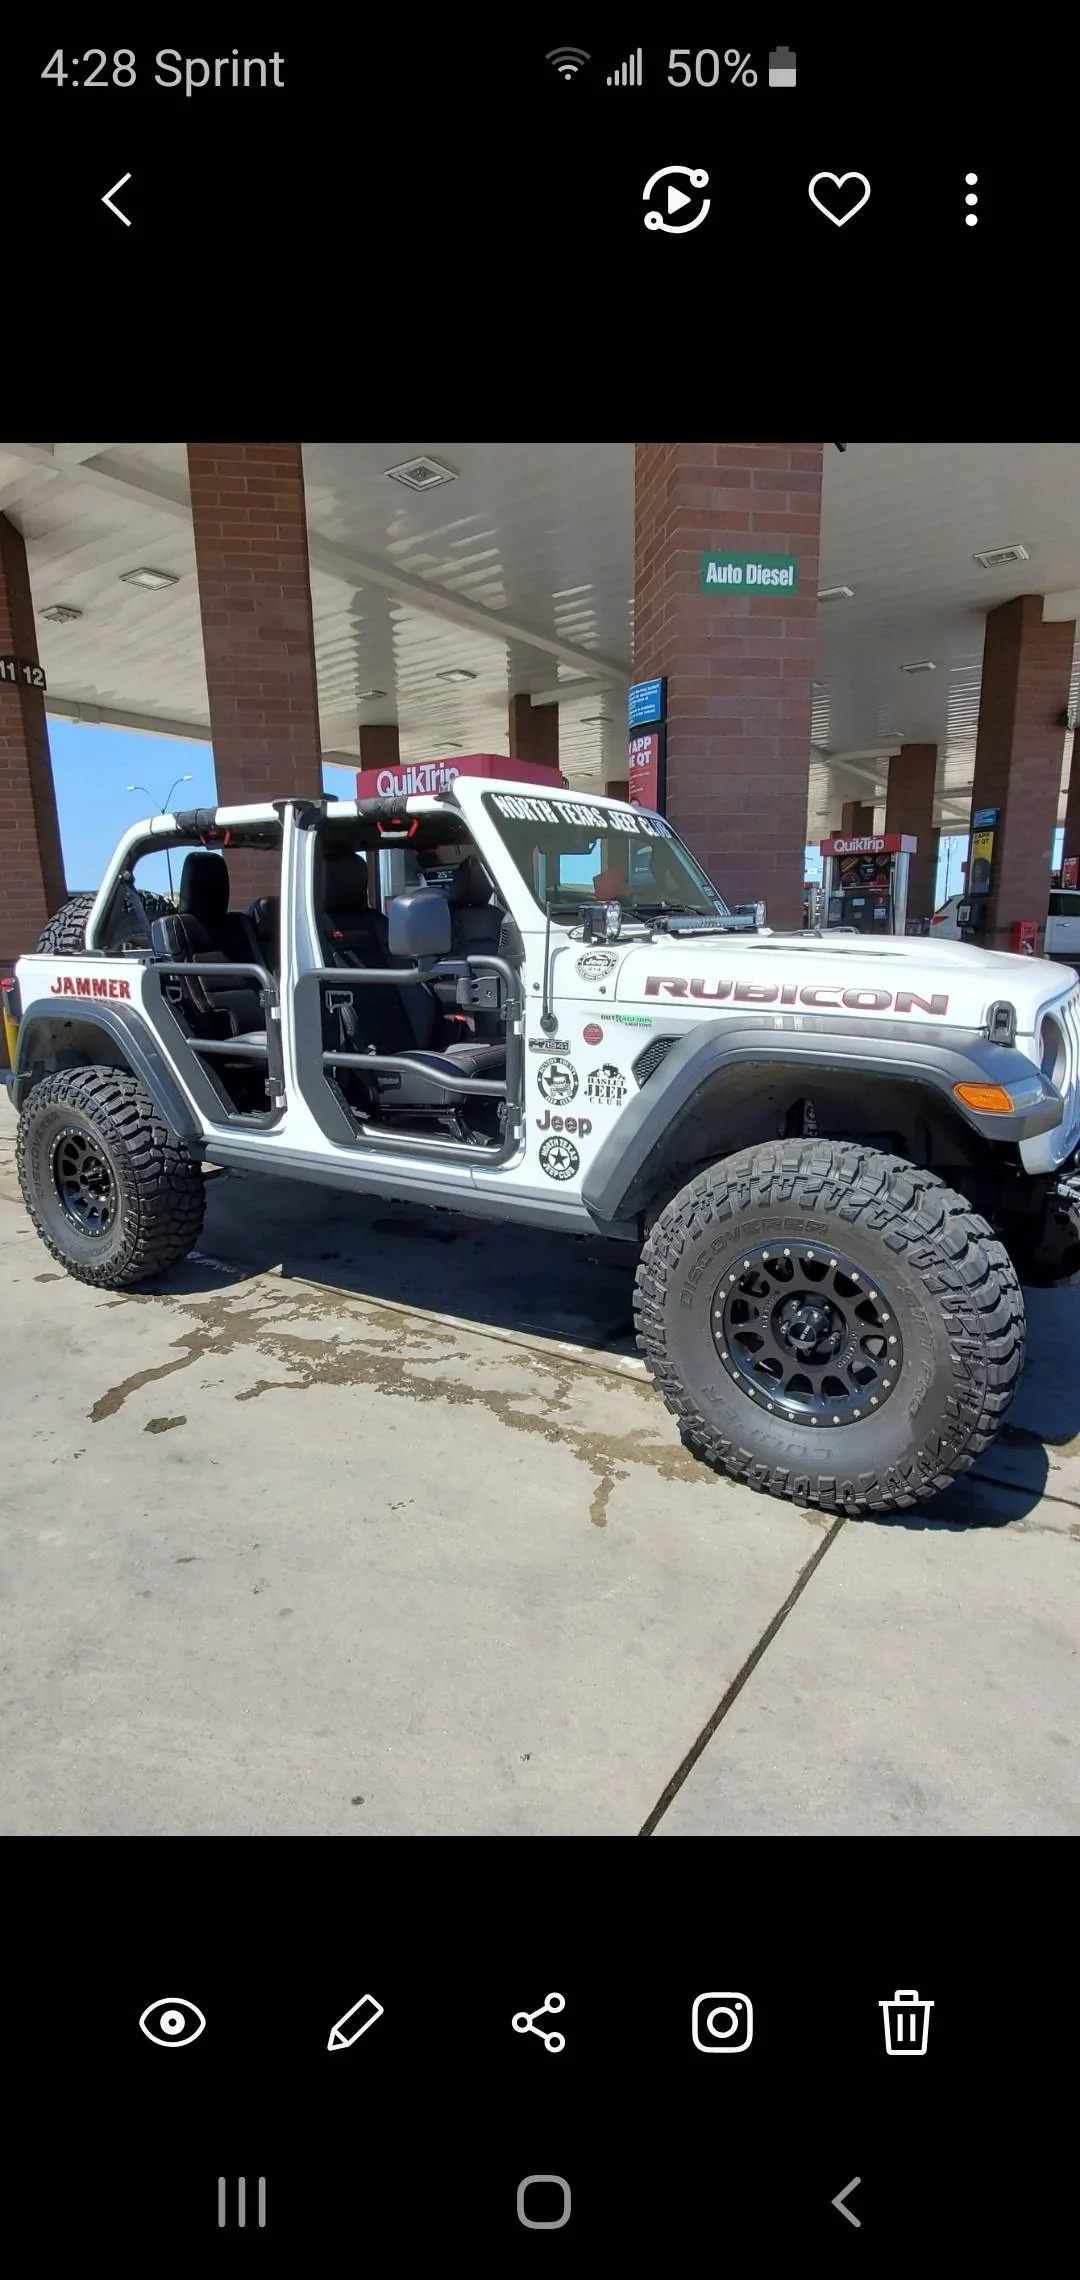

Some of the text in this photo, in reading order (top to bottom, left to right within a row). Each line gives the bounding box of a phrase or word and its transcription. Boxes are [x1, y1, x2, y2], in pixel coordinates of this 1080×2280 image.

[706, 562, 794, 586] Auto Diesel
[0, 660, 45, 687] 11 12
[632, 736, 652, 754] APP
[637, 751, 652, 767] QT
[491, 794, 673, 839] NORTH TEXAS JEEP CLUB
[834, 837, 885, 853] QuikTrip
[51, 976, 132, 1000] JAMMER
[644, 976, 950, 1016] RUBICON
[584, 1085, 628, 1099] JEEP
[587, 1077, 625, 1087] HASLET
[589, 1096, 622, 1106] CLUB
[536, 1109, 593, 1139] Jeep
[541, 1138, 578, 1161] NORTH TEXAS
[542, 1162, 575, 1179] JEEP CLUB
[680, 1216, 830, 1311] DISCOVERER
